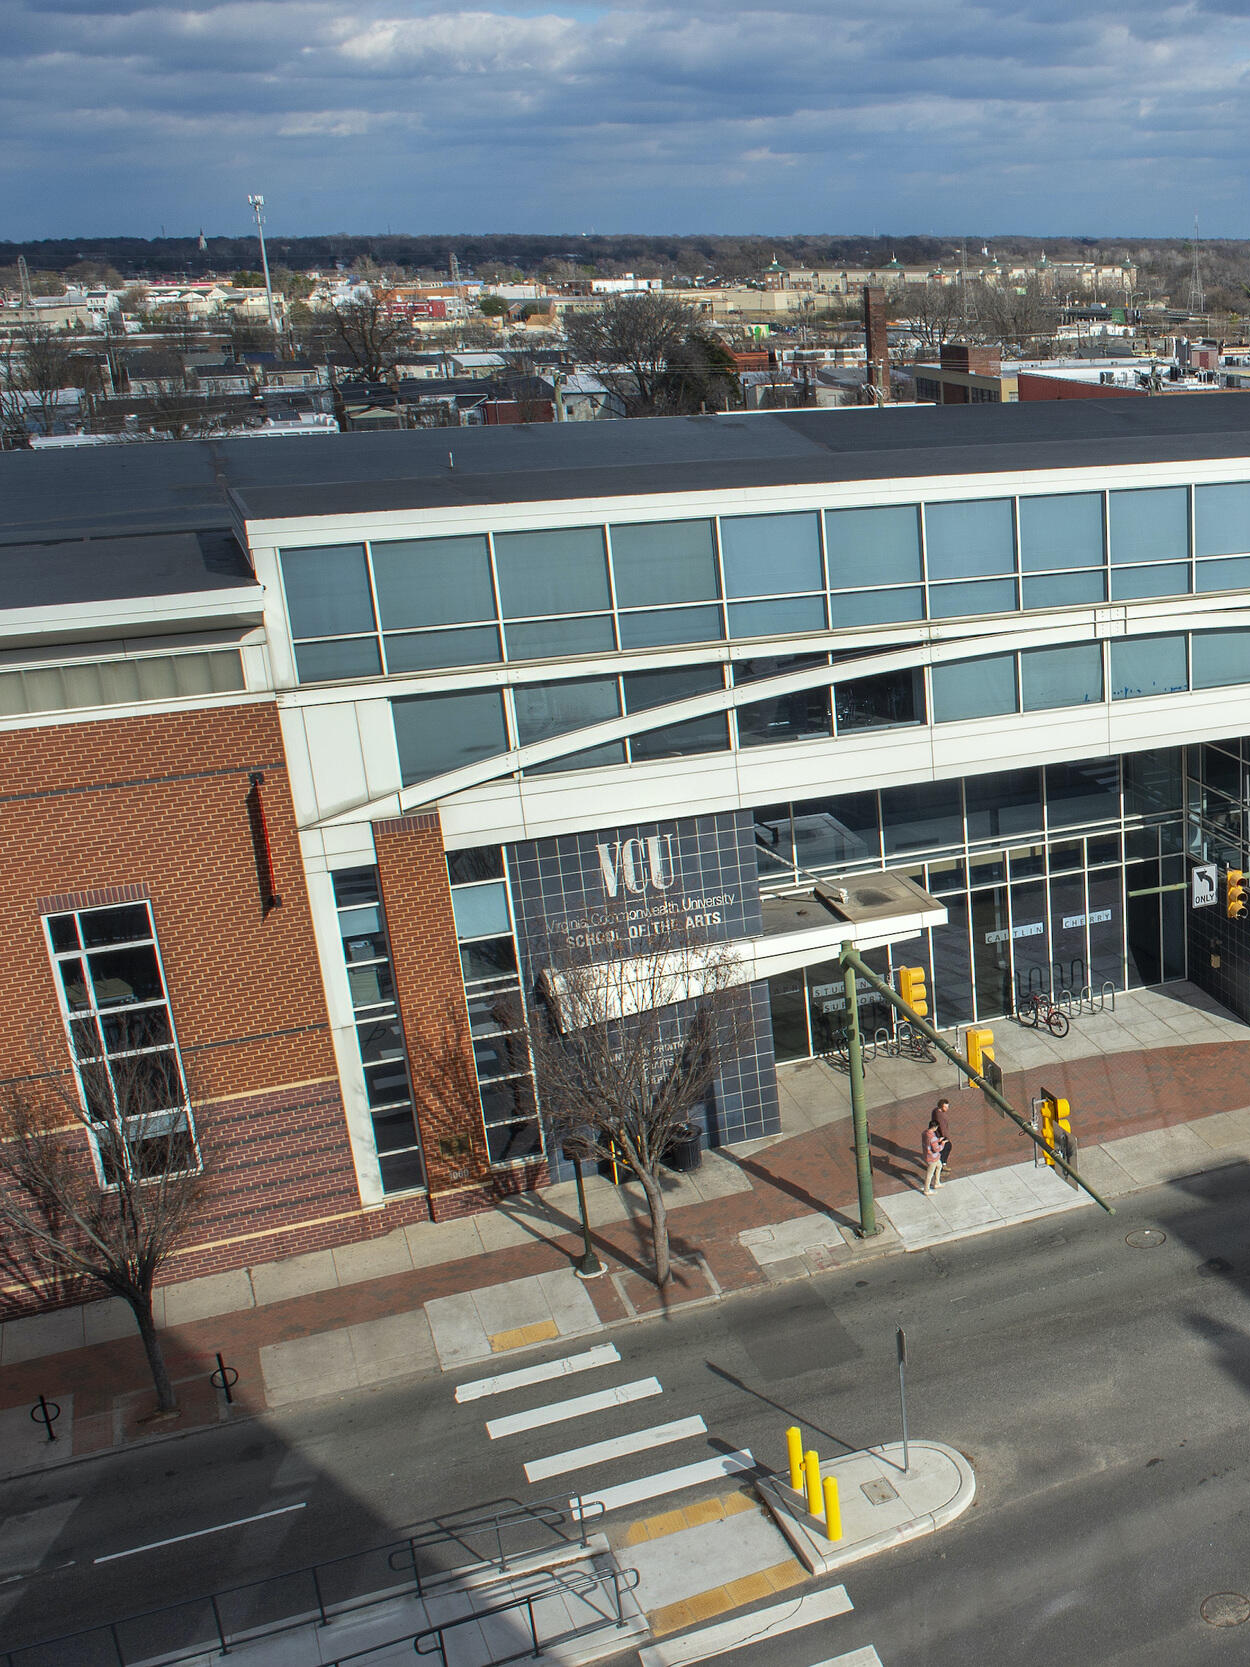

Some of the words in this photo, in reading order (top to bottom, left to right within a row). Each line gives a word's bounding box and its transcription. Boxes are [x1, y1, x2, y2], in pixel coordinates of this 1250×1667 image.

[595, 833, 674, 898] VCU
[547, 916, 588, 934] Virginia
[591, 901, 679, 926] Commonwealth
[682, 892, 735, 911] University
[1195, 893, 1215, 904] ONLY
[566, 929, 619, 949] SCHOOL
[628, 923, 647, 939] OF
[685, 911, 722, 930] ARTS
[986, 926, 1043, 943] CAITLIN
[1064, 912, 1110, 928] CHERRY
[824, 993, 883, 1012] SUPORT
